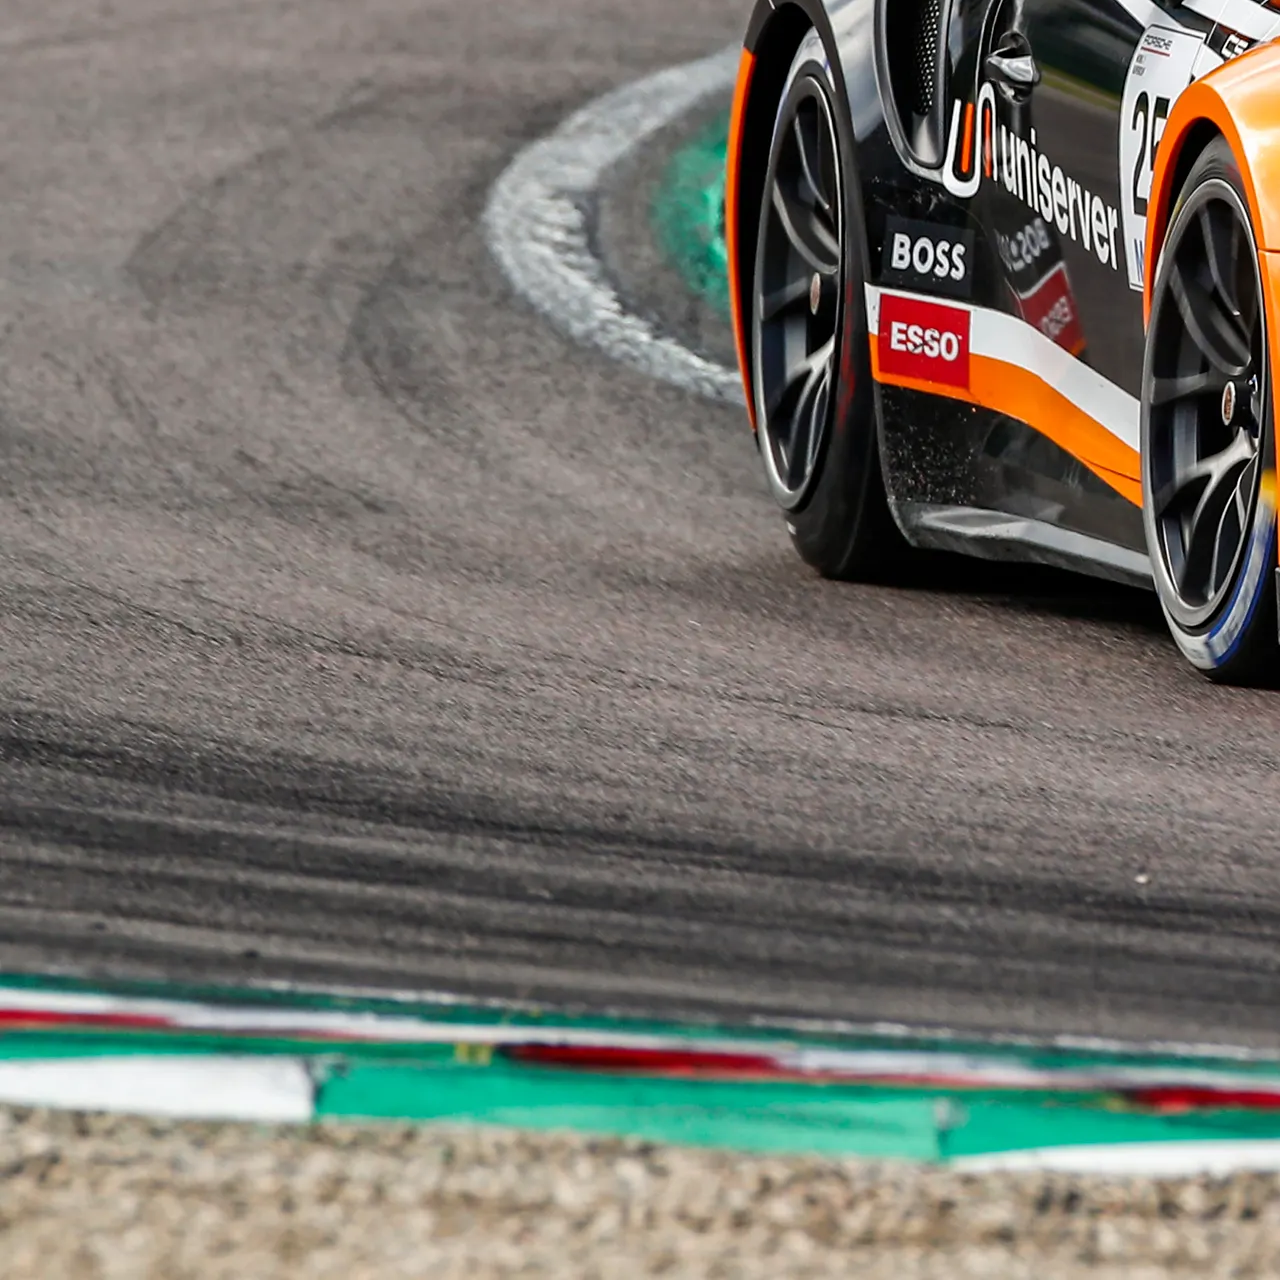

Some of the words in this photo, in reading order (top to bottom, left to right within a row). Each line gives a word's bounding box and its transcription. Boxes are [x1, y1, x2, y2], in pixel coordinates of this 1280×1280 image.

[1001, 124, 1118, 271] uniserver
[891, 233, 966, 281] BOSS
[890, 321, 959, 361] ESSO
